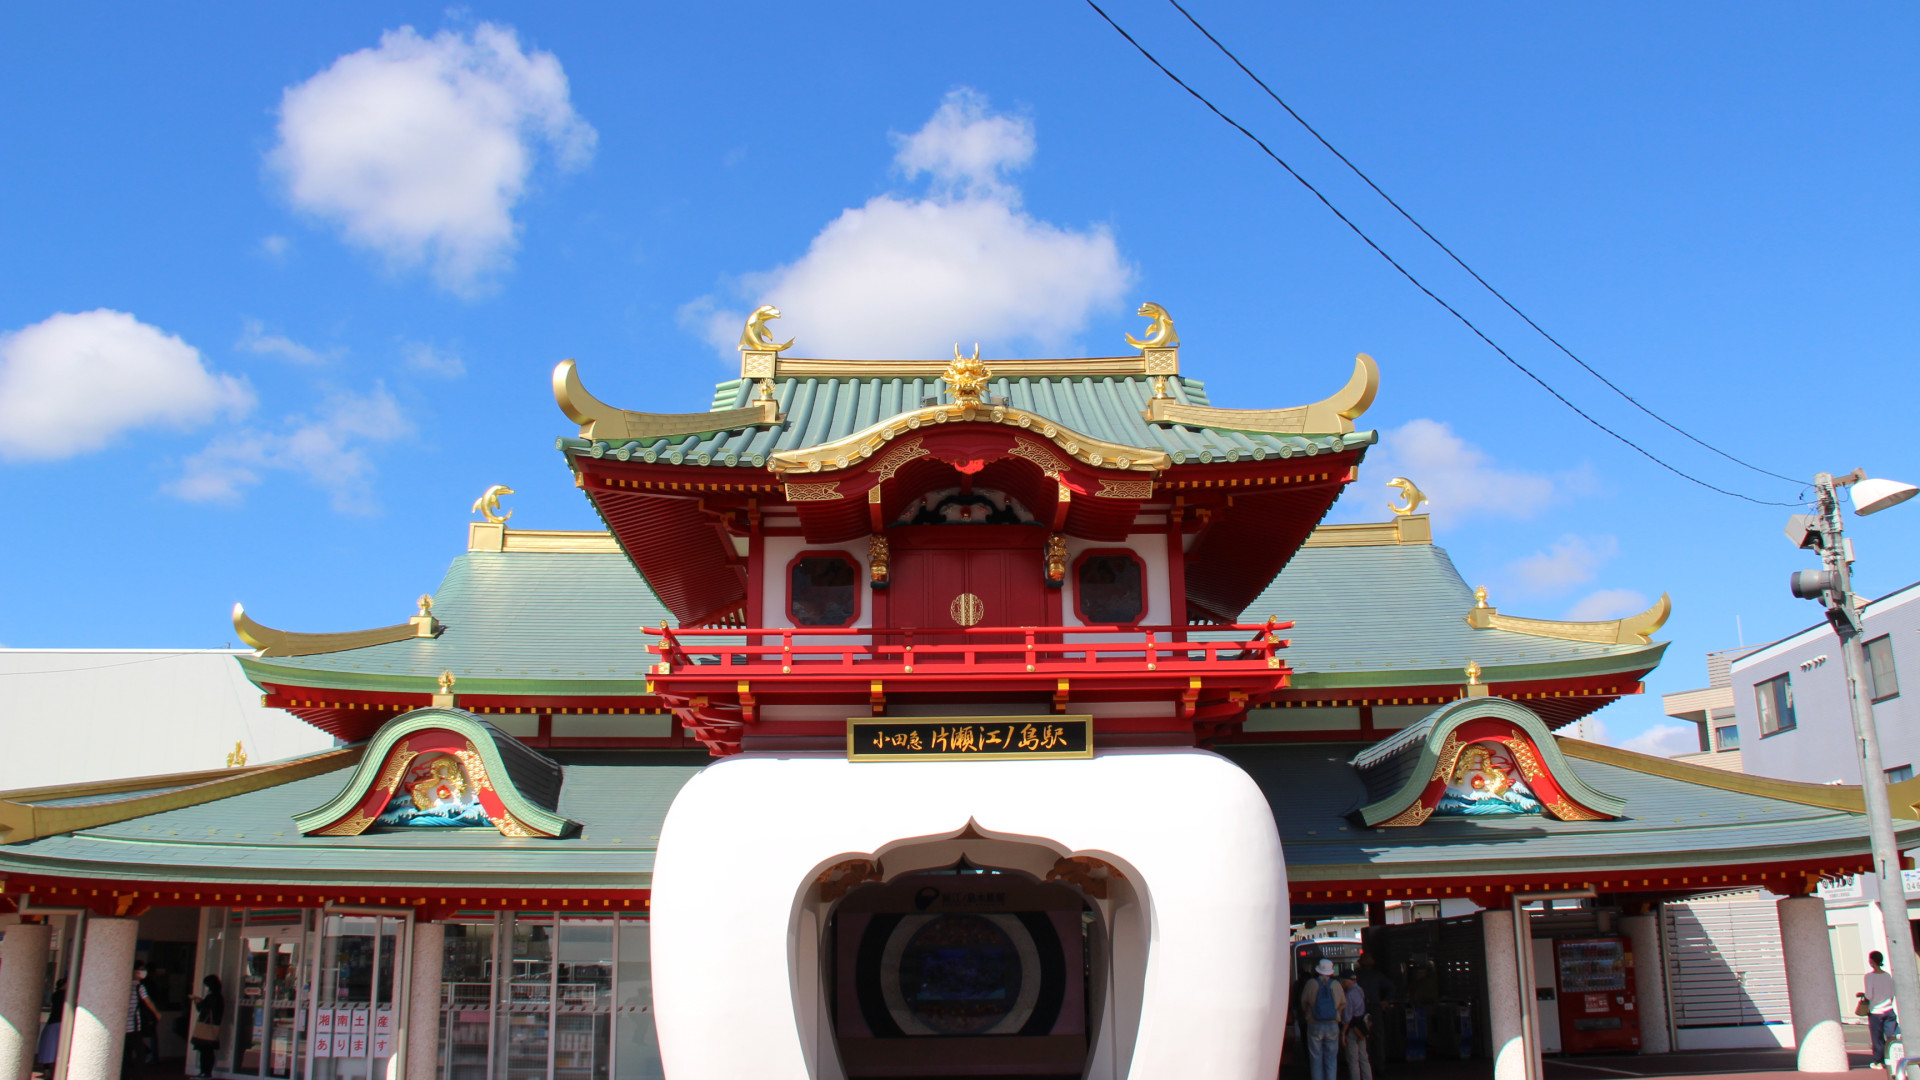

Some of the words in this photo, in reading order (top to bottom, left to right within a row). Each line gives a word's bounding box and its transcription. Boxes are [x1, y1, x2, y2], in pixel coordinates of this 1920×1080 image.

[872, 730, 923, 750] 小田急
[931, 723, 1068, 752] 片瀬江ノ島駅
[318, 1014, 389, 1028] 湘南土産
[317, 1038, 388, 1052] あります
